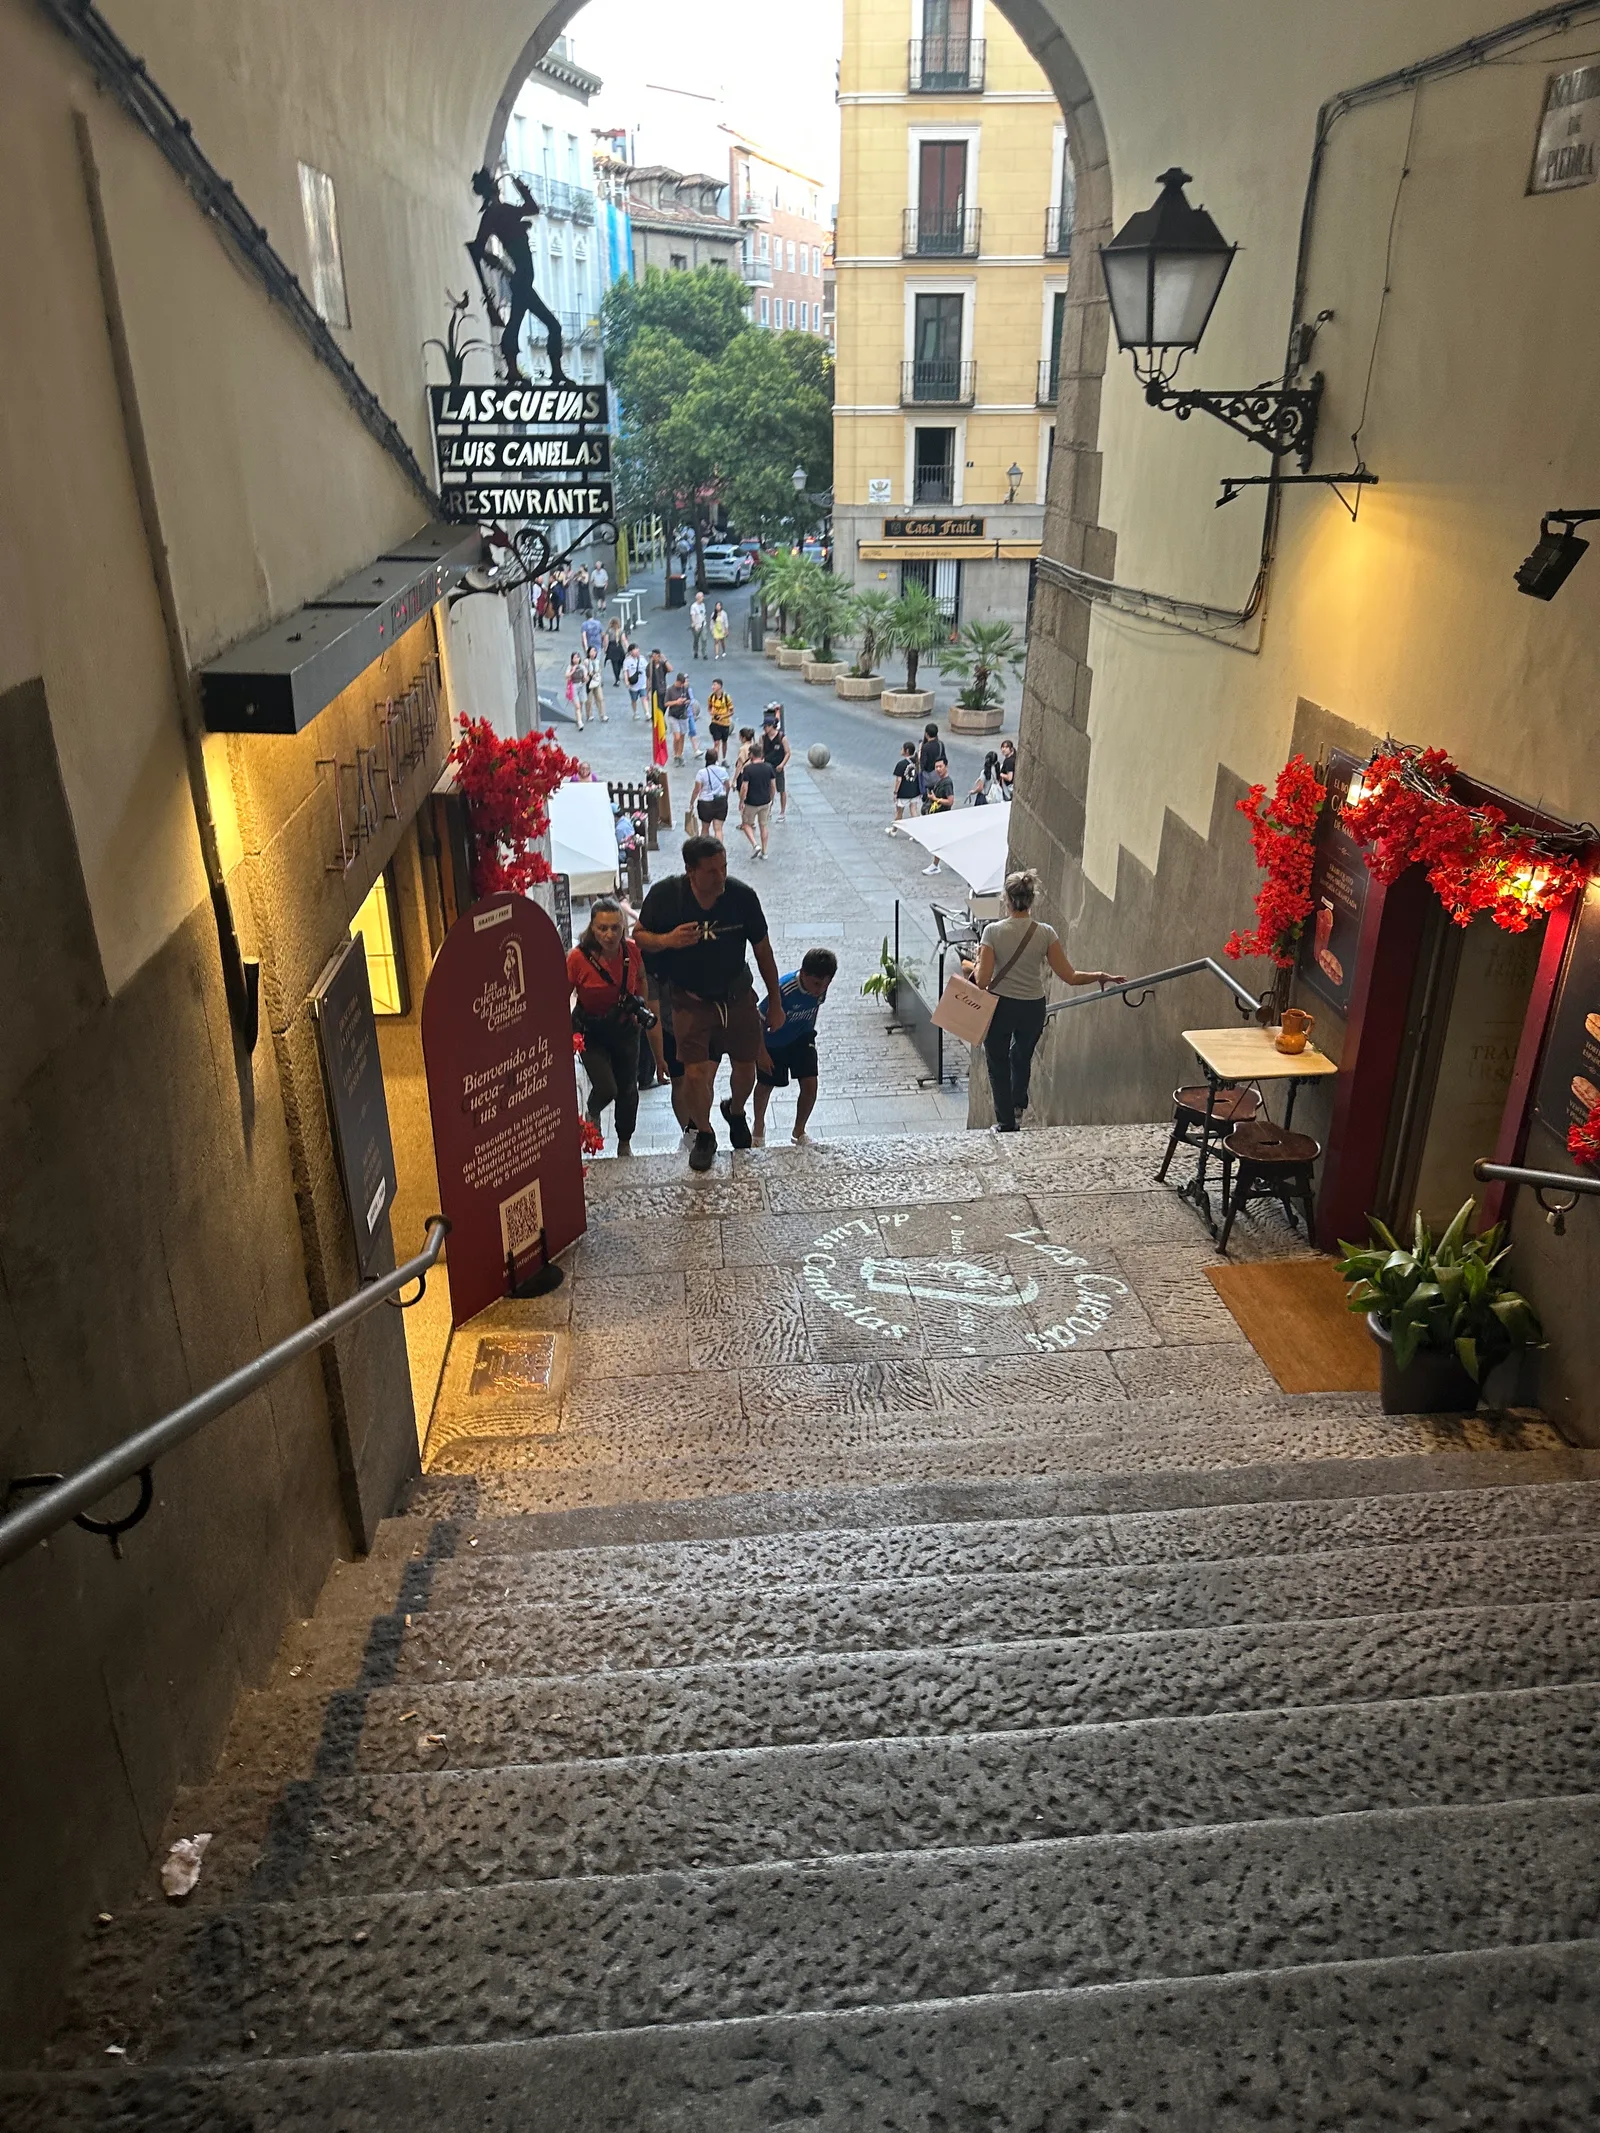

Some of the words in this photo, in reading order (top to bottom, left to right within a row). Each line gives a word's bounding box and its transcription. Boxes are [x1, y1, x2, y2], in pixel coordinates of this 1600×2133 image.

[440, 389, 497, 422] LAS
[502, 390, 600, 421] CUEVAS
[904, 520, 937, 535] Casa
[938, 520, 978, 536] Fraile
[472, 984, 508, 1014] Cuevas
[483, 980, 498, 996] Las
[487, 1000, 528, 1032] Candelas
[462, 1047, 527, 1096] Bienvenido
[528, 1044, 536, 1060] a
[538, 1035, 549, 1054] la
[541, 1050, 554, 1071] de
[462, 1158, 477, 1175] del
[477, 1135, 518, 1166] bandolero
[534, 1107, 562, 1130] famoso
[474, 1127, 513, 1156] Descubre
[513, 1121, 522, 1133] la
[521, 1103, 551, 1128] historia
[464, 1172, 476, 1185] de
[477, 1151, 506, 1178] Madrid
[513, 1133, 538, 1154] través
[537, 1126, 548, 1138] de
[547, 1117, 562, 1132] una
[474, 1154, 521, 1190] experiencia
[520, 1131, 556, 1159] inmersiva
[492, 1176, 504, 1190] de
[511, 1150, 542, 1177] minutos
[812, 1218, 878, 1250] Luis
[876, 1212, 910, 1227] de
[1004, 1224, 1089, 1266] Las
[802, 1252, 911, 1338] Candelas
[1025, 1273, 1129, 1352] Cuevas
